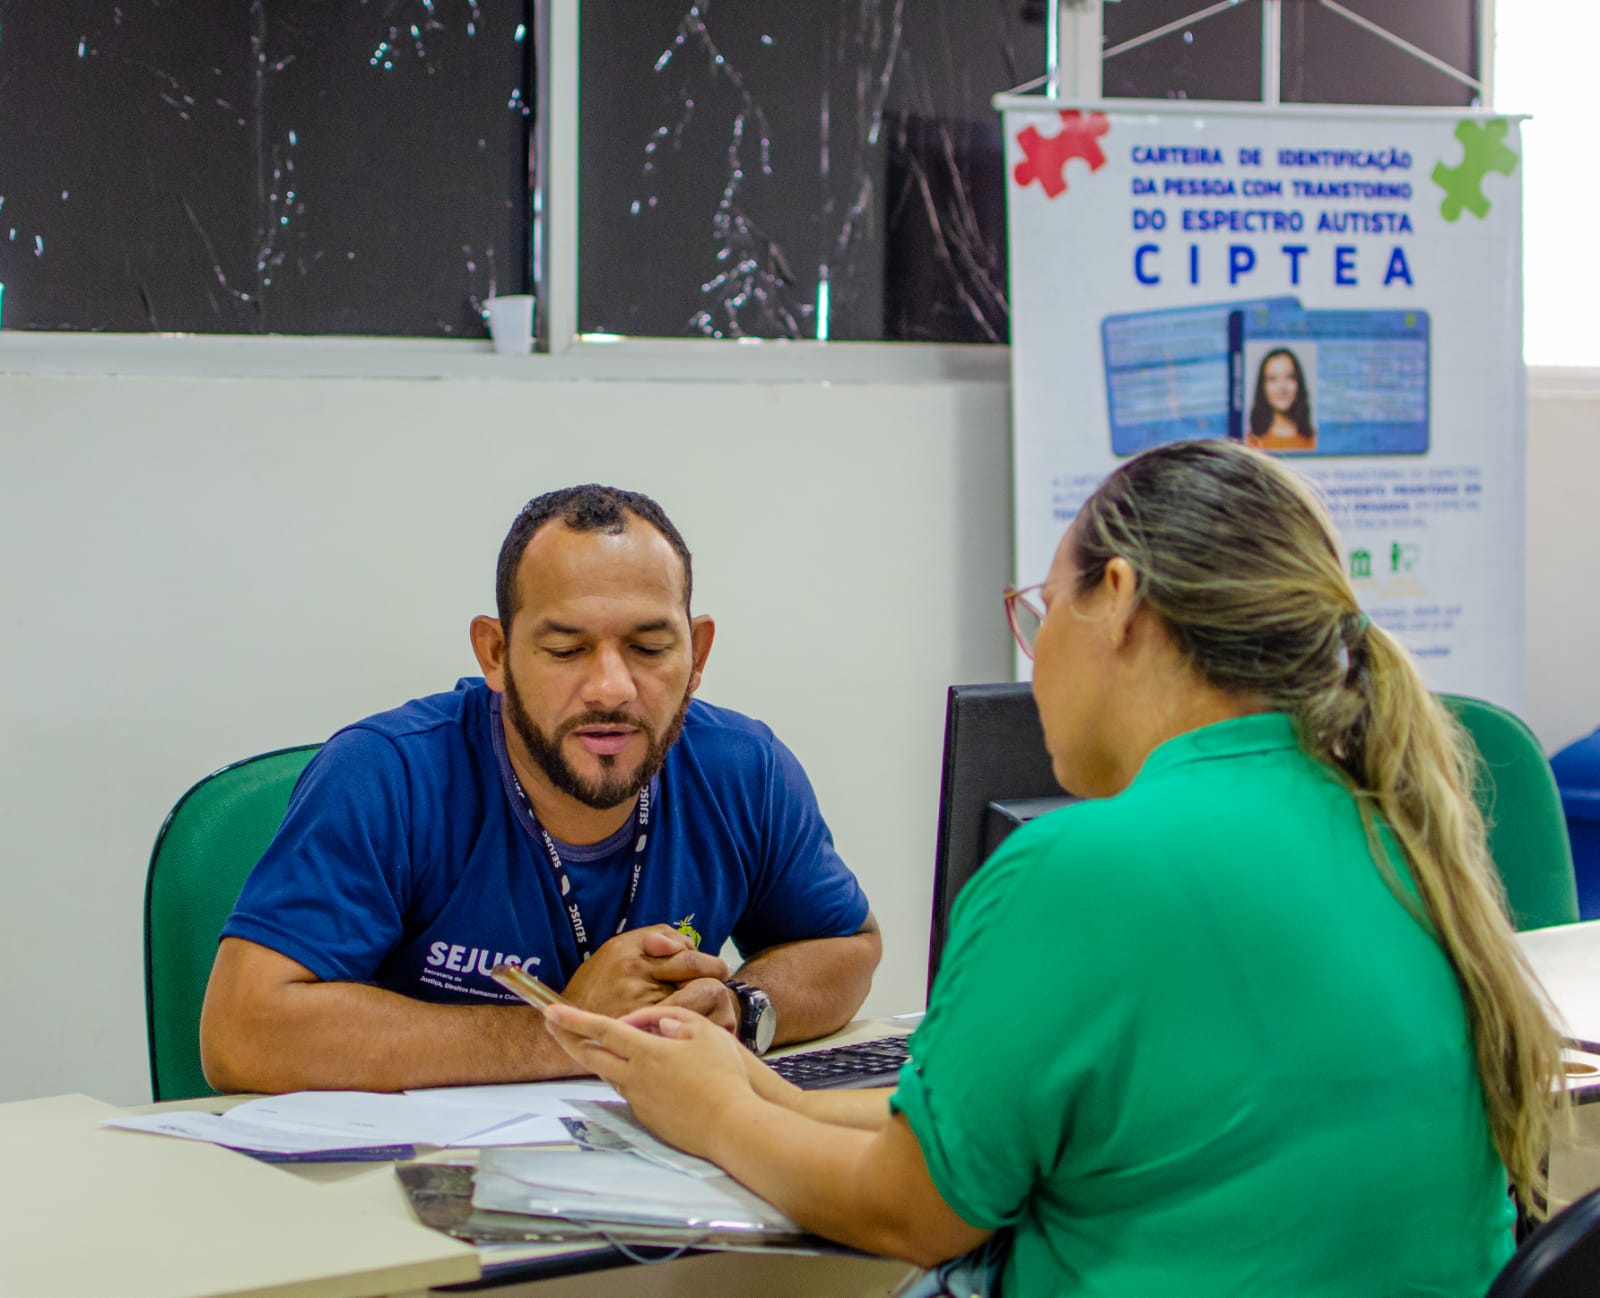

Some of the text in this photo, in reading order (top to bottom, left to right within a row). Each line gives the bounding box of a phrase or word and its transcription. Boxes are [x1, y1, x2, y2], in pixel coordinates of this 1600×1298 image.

[1132, 147, 1412, 171] CARTEIRA DE IDENTIFICAÇÃO
[1132, 178, 1412, 199] DA PESSOA COM TRANSTORNO
[1133, 209, 1413, 234] DO ESPECTRO AUTISTA
[639, 785, 649, 825] SEJUSC
[568, 904, 587, 942] SEJUSC
